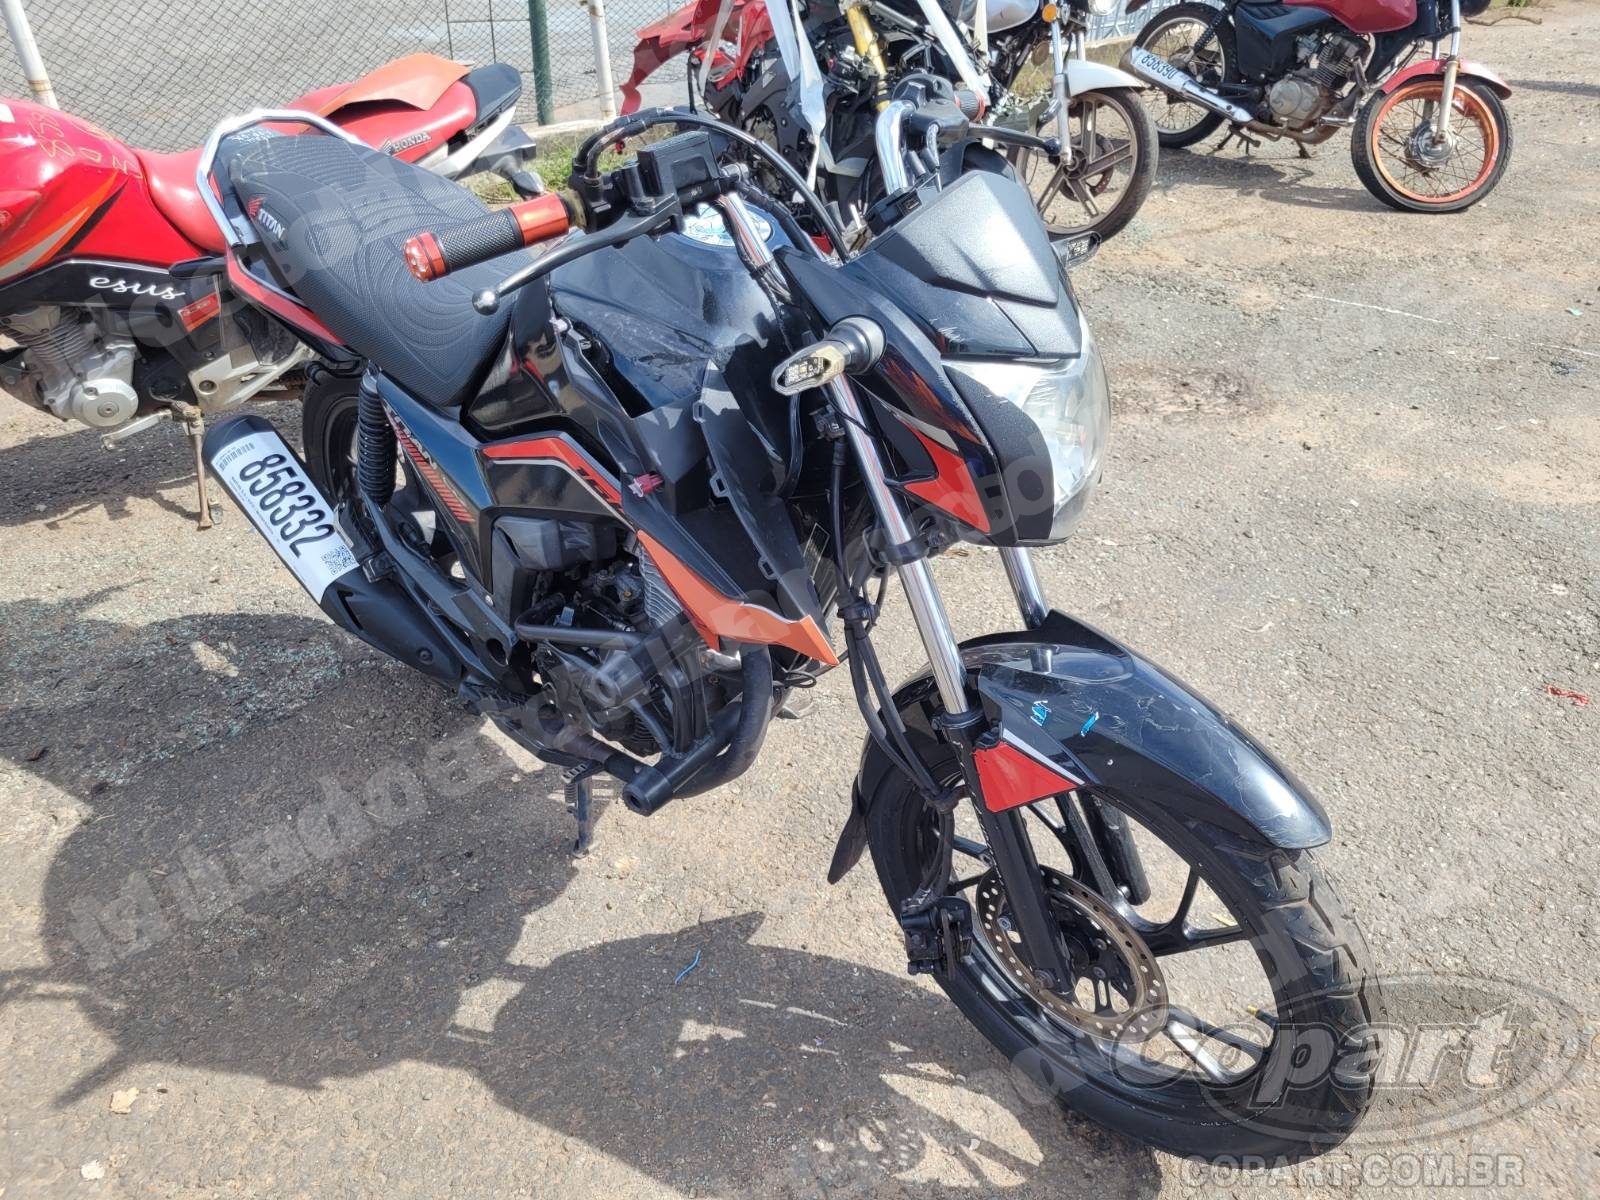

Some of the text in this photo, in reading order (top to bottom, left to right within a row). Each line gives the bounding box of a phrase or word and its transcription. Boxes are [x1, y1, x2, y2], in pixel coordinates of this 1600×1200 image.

[394, 131, 432, 152] HONDA
[258, 208, 286, 239] TITAN
[89, 277, 186, 300] esus
[239, 453, 335, 559] 858332
